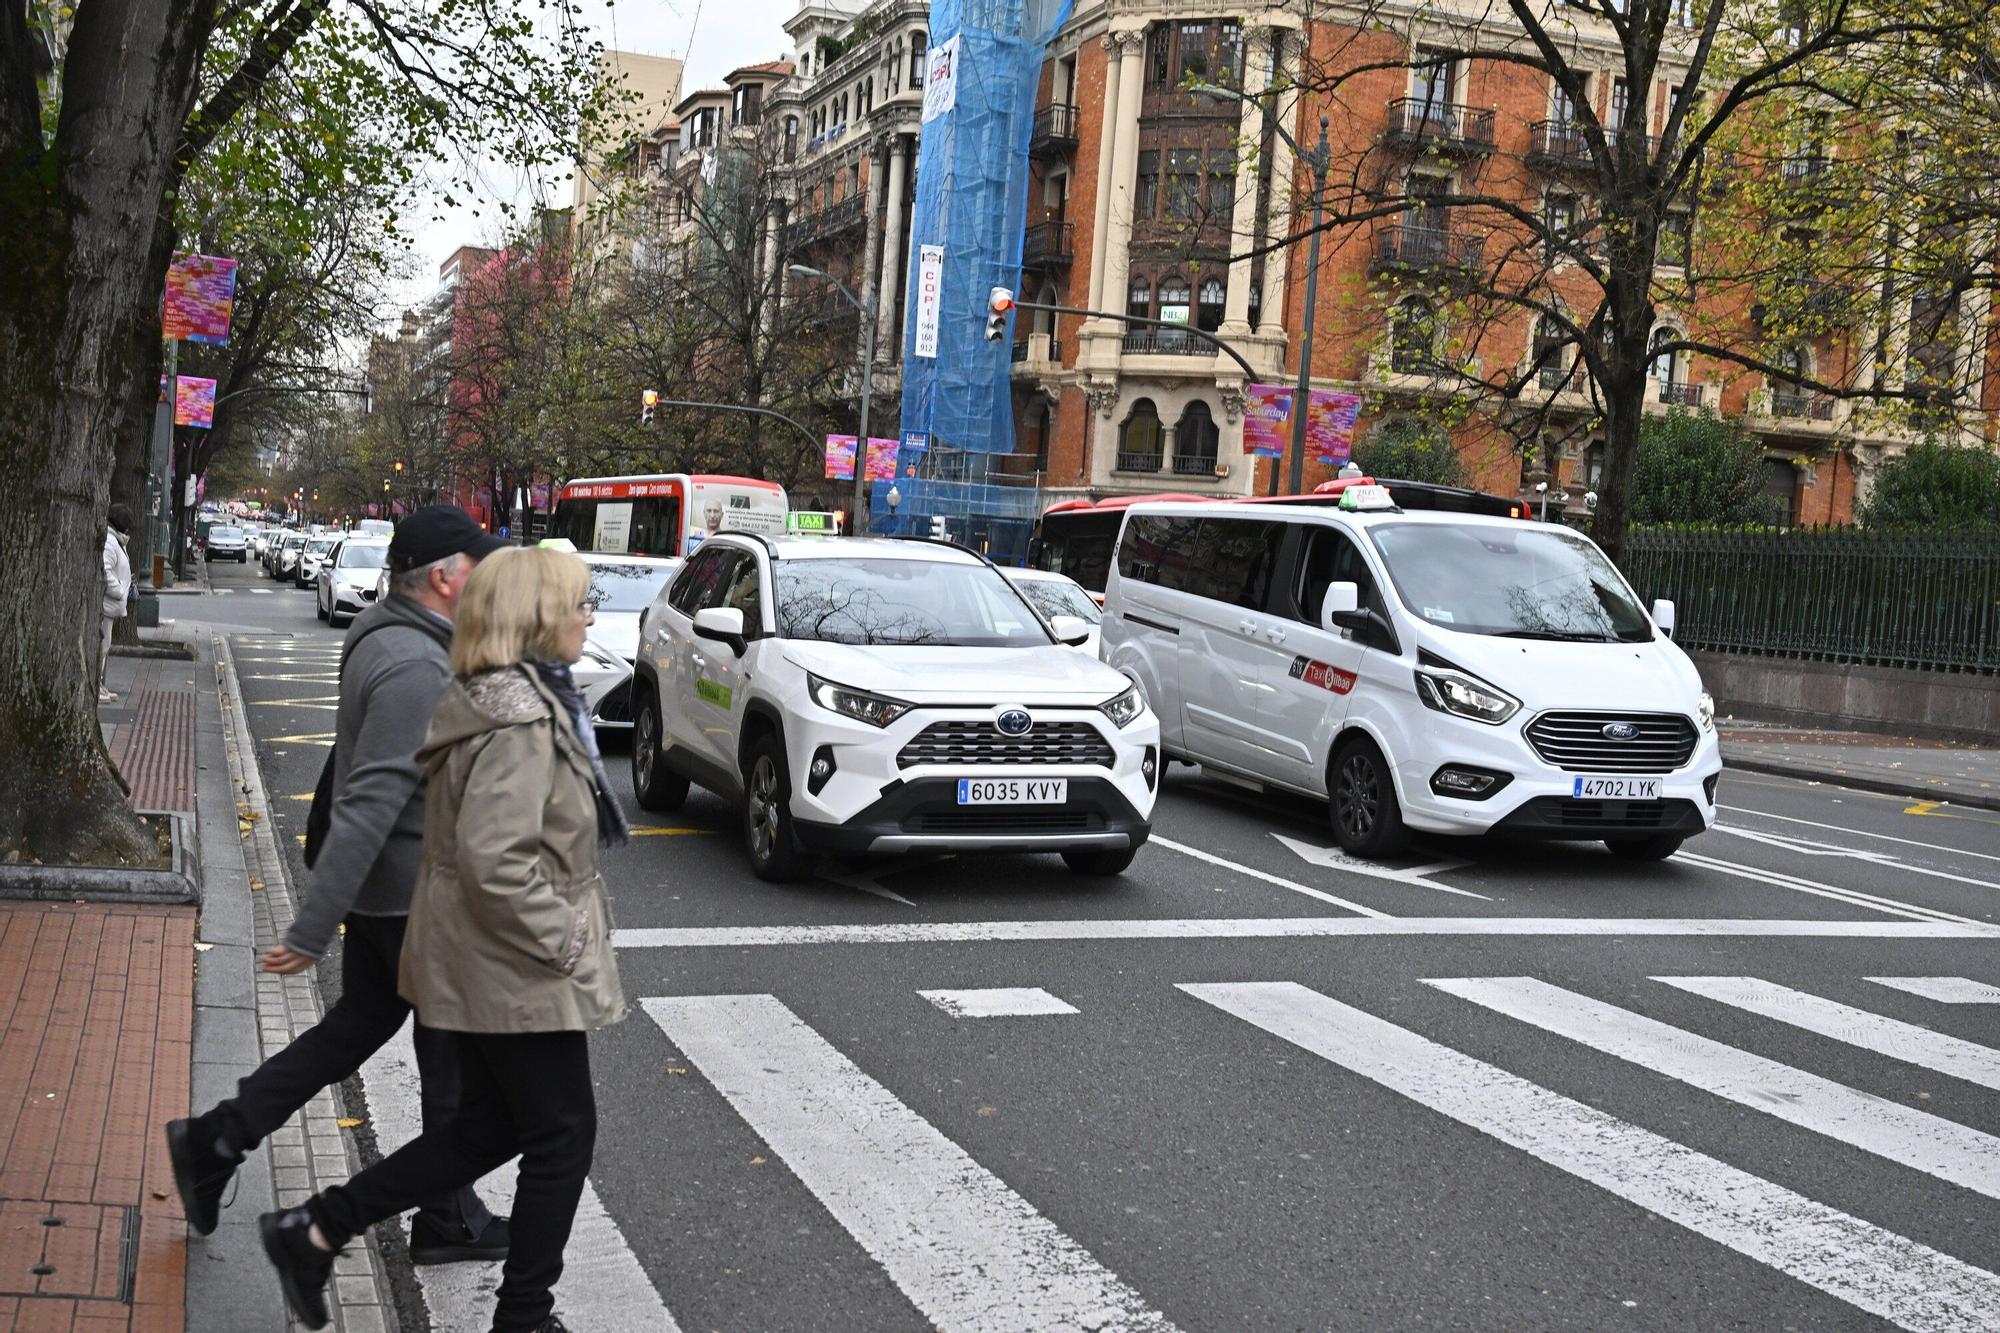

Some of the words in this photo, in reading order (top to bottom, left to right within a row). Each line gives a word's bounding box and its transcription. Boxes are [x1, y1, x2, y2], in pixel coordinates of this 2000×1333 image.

[925, 271, 935, 316] COPI
[922, 323, 934, 331] 944
[921, 333, 933, 342] 168
[920, 344, 933, 352] 912
[1247, 395, 1264, 405] Fair
[1246, 405, 1288, 421] Saturday
[800, 515, 823, 528] TAXI
[1310, 665, 1325, 681] Taxi
[1325, 667, 1350, 690] Bilbao
[1611, 725, 1633, 737] Ford
[972, 782, 1019, 801] 6035
[1027, 782, 1061, 800] KVY
[1585, 780, 1624, 797] 4702
[1628, 781, 1656, 797] LYK
